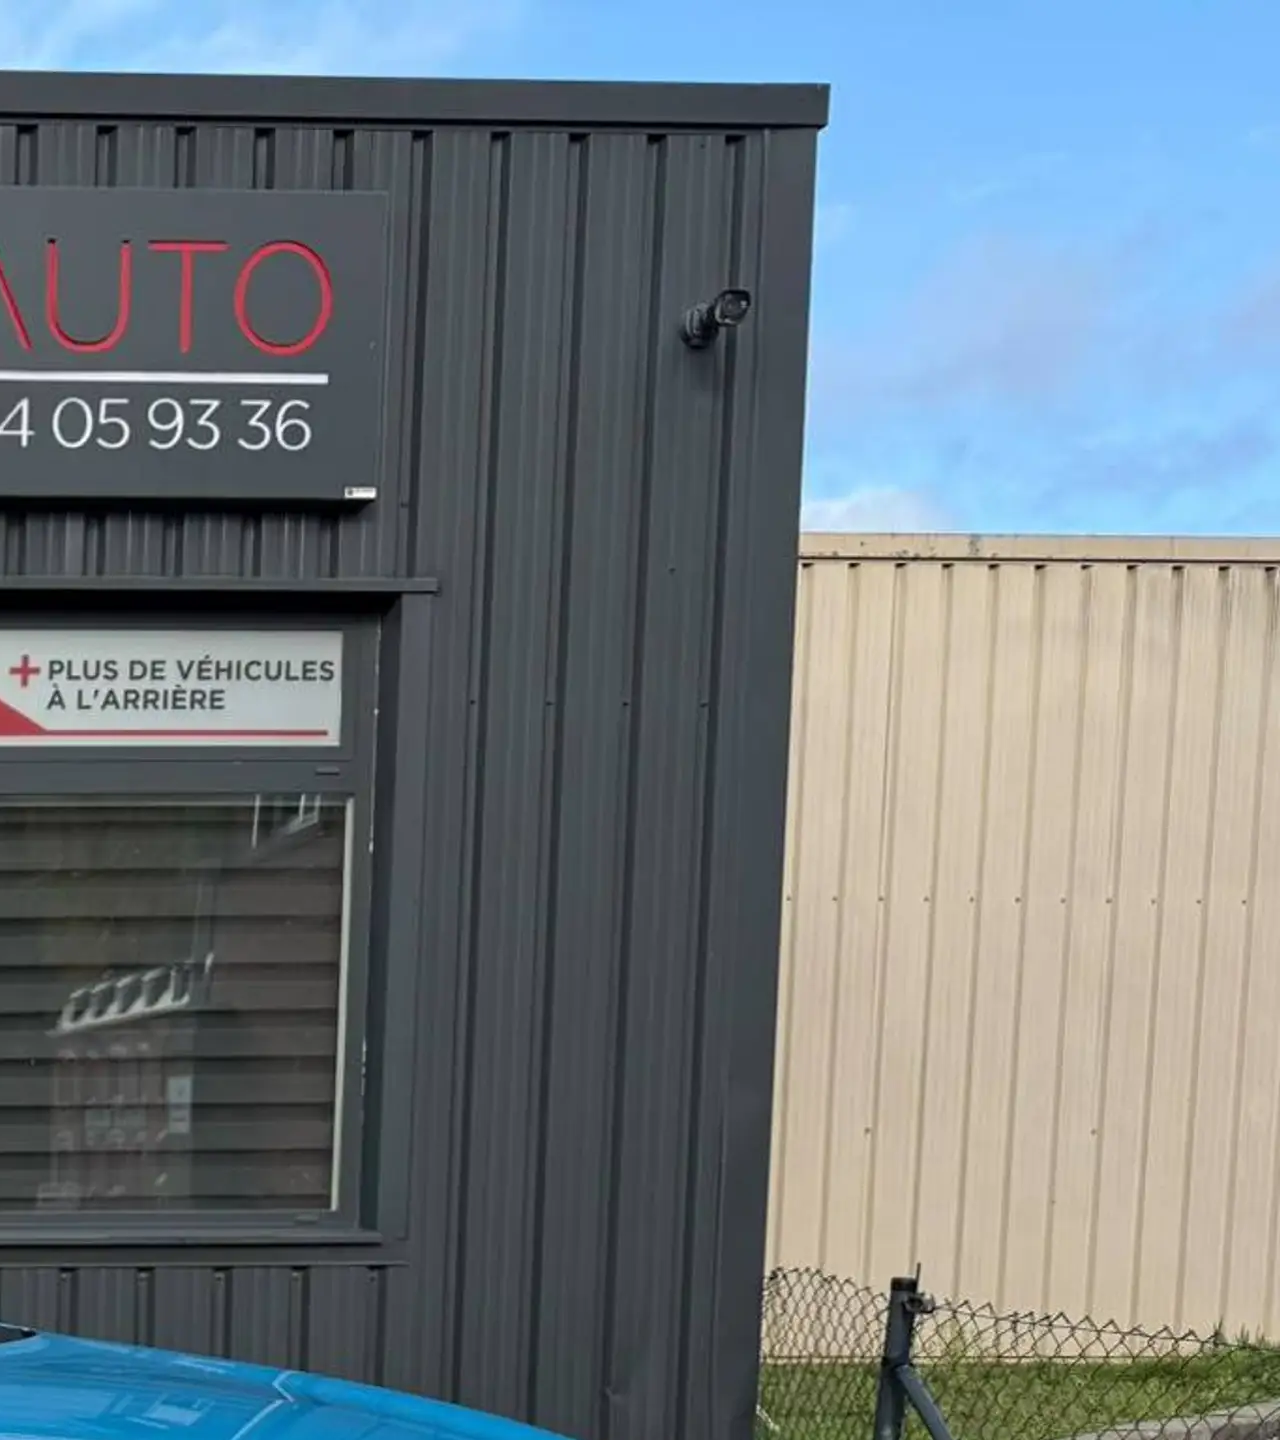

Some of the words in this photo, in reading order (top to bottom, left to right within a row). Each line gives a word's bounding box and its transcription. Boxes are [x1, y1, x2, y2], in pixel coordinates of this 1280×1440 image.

[52, 397, 131, 450] 05
[146, 398, 221, 450] 93
[237, 399, 312, 451] 36
[48, 659, 119, 682] PLUS
[128, 660, 168, 682] DE
[176, 655, 335, 682] VÉHICULES
[46, 683, 67, 710] À
[77, 683, 227, 711] L'ARRIÈRE
